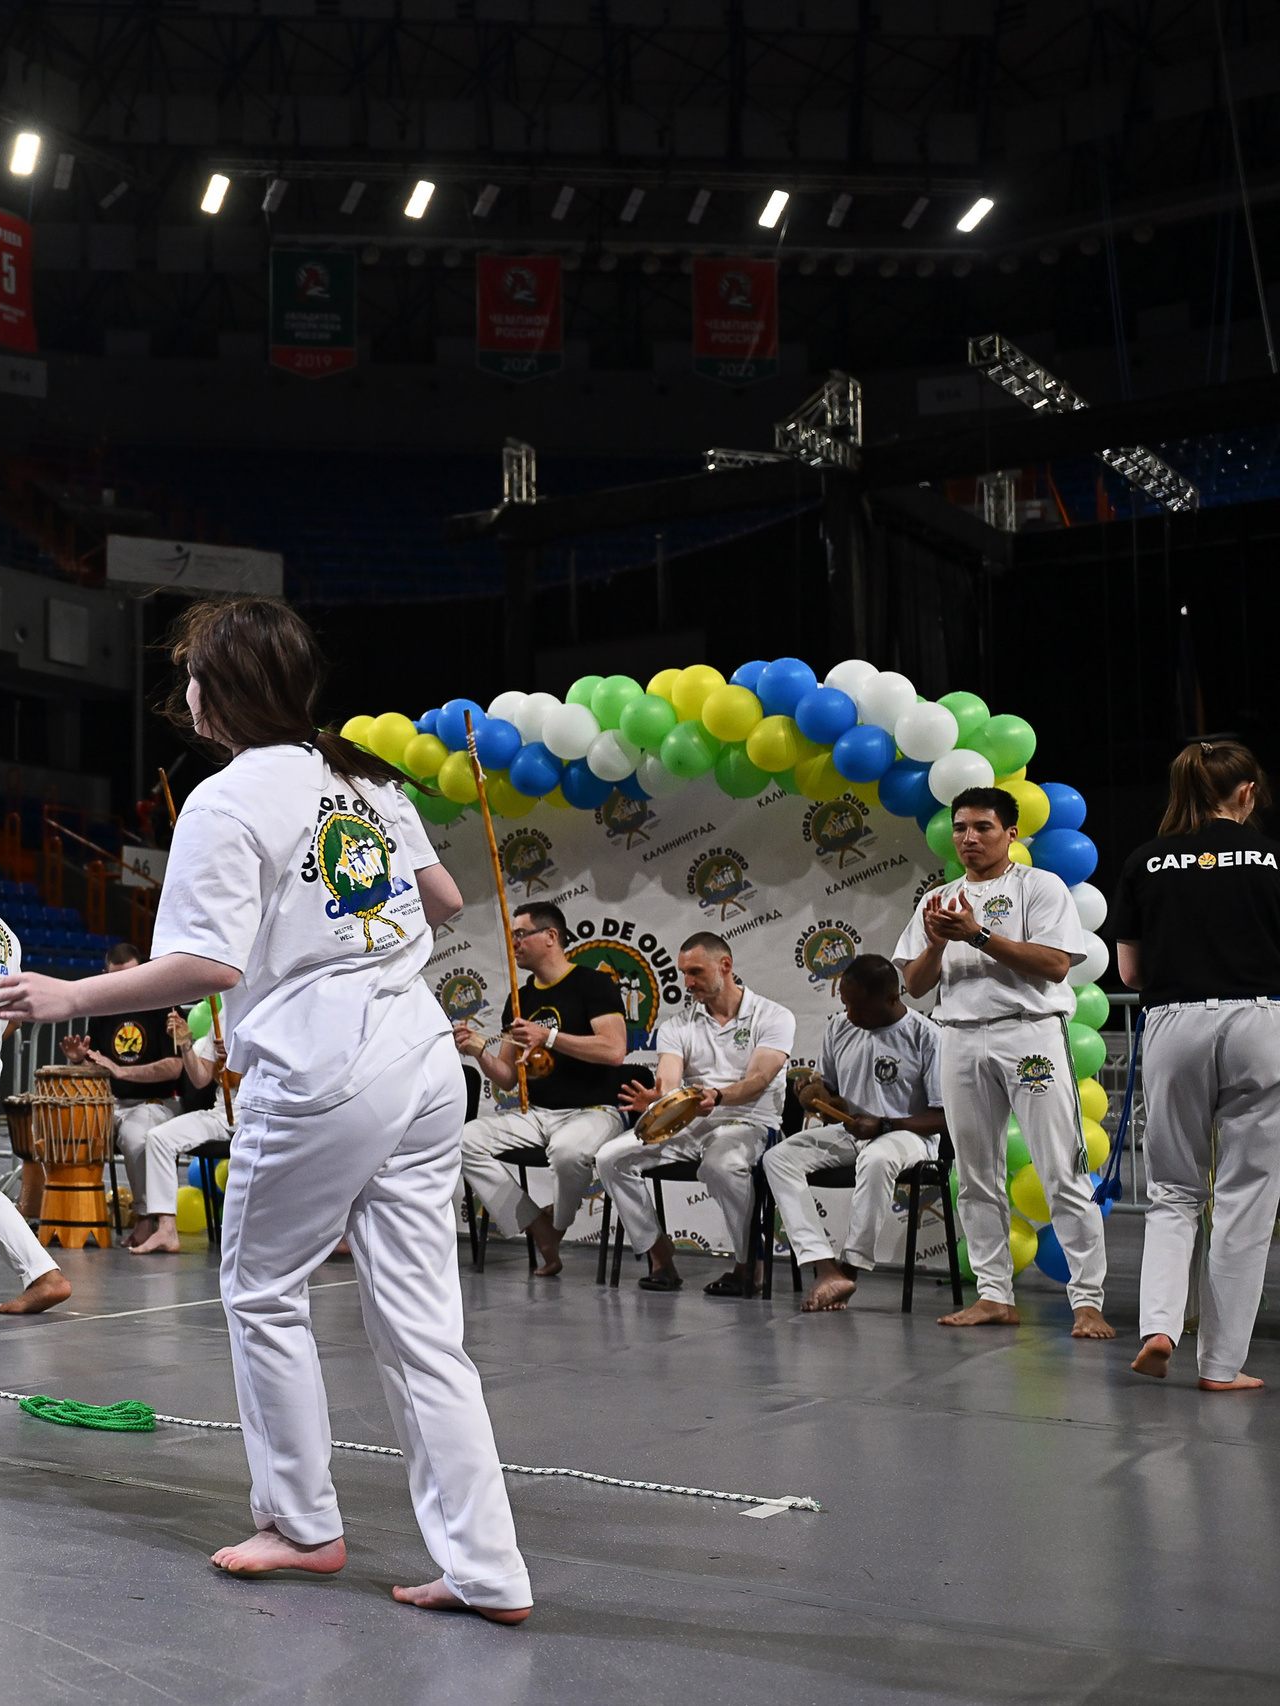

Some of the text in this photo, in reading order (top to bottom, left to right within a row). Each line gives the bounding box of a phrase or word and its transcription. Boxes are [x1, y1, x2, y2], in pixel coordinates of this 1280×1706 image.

[1, 251, 17, 295] 5
[489, 314, 550, 326] ЧЕМПИОН
[495, 327, 545, 338] РОССИИ
[295, 354, 332, 368] 2019
[501, 357, 539, 372] 2021
[717, 363, 755, 377] 2022
[842, 792, 870, 816] OURO
[516, 828, 529, 837] DE
[530, 828, 553, 851] OURO
[642, 822, 716, 863] КАЛИНИНГРАД
[132, 858, 151, 877] A6
[687, 852, 707, 895] CORDÃO
[709, 847, 722, 857] DE
[724, 848, 749, 871] OURO
[825, 854, 908, 896] КАЛИНИНГРАД
[794, 919, 862, 969] CORDÃO DE OURO
[602, 918, 636, 942] DE
[638, 933, 682, 1005] OURO
[453, 967, 465, 976] DE
[466, 968, 487, 990] OURO
[674, 1229, 712, 1251] DE OUR
